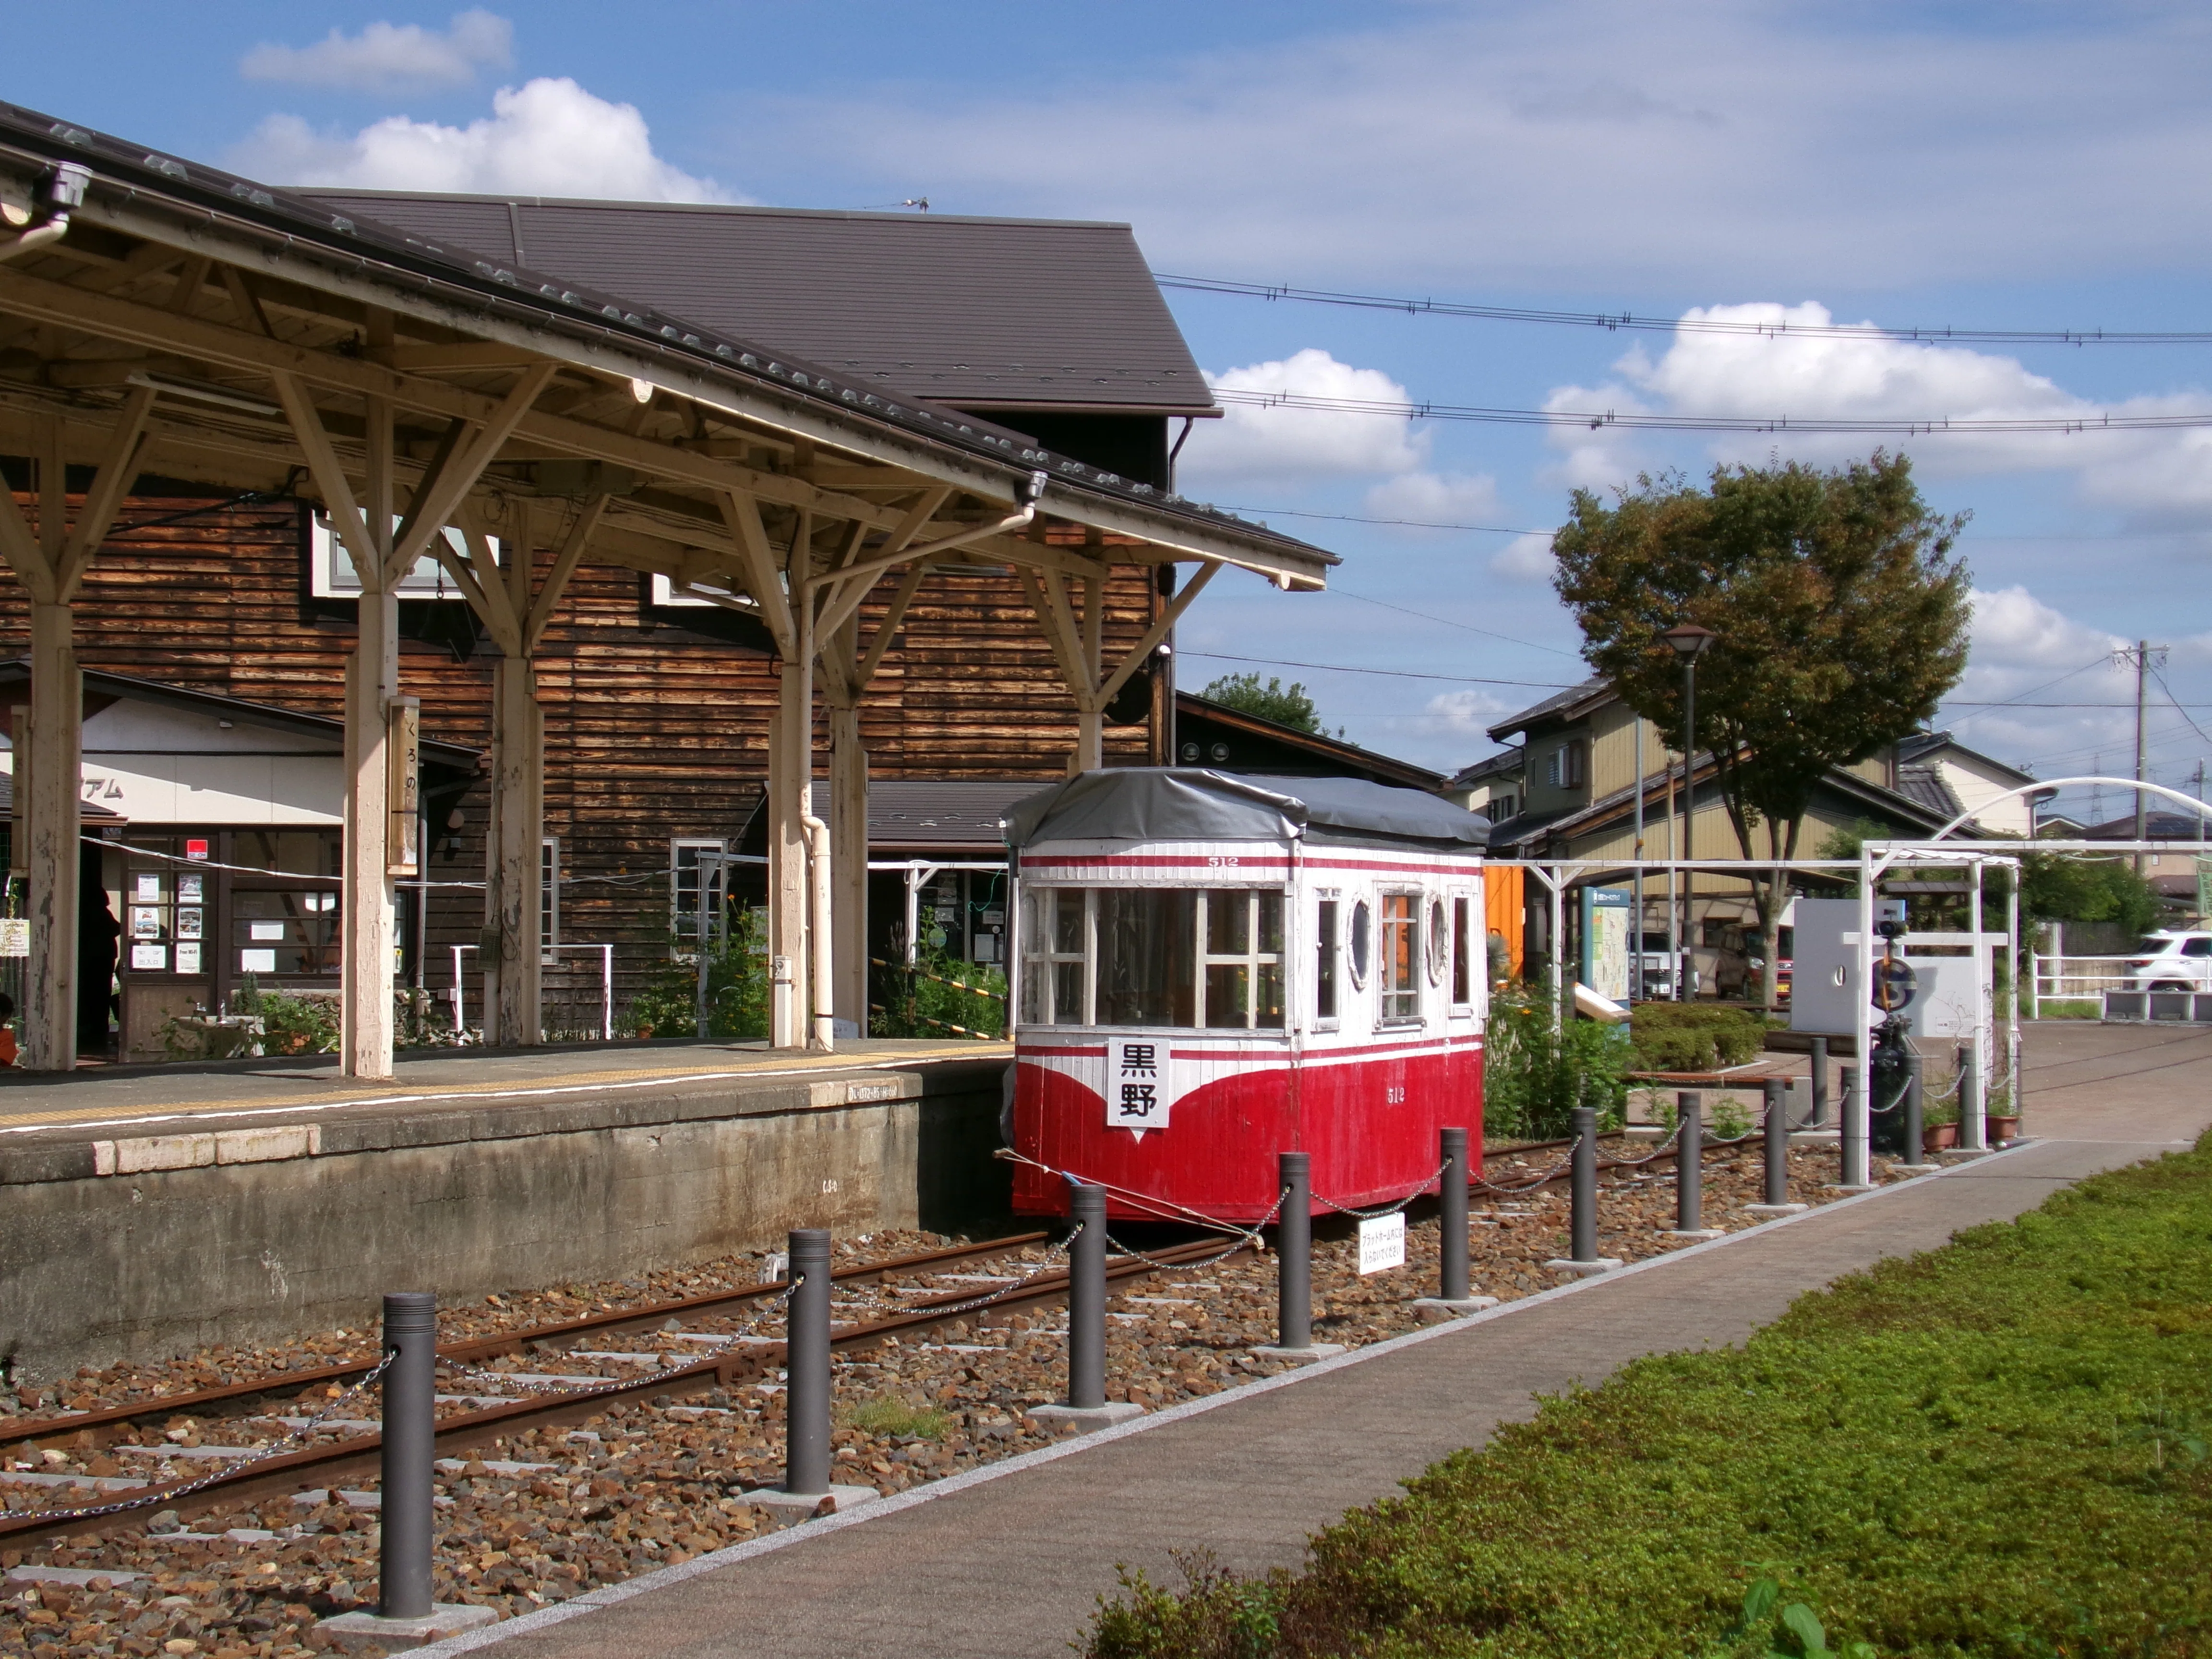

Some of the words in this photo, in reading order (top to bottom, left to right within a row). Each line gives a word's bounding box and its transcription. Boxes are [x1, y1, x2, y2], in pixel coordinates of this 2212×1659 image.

[407, 722, 416, 790] くろの
[81, 777, 123, 799] アム
[1208, 857, 1238, 867] 512
[1120, 1044, 1157, 1117] 黒野
[1388, 1087, 1405, 1104] 512
[1364, 1245, 1401, 1265] 入らないでください
